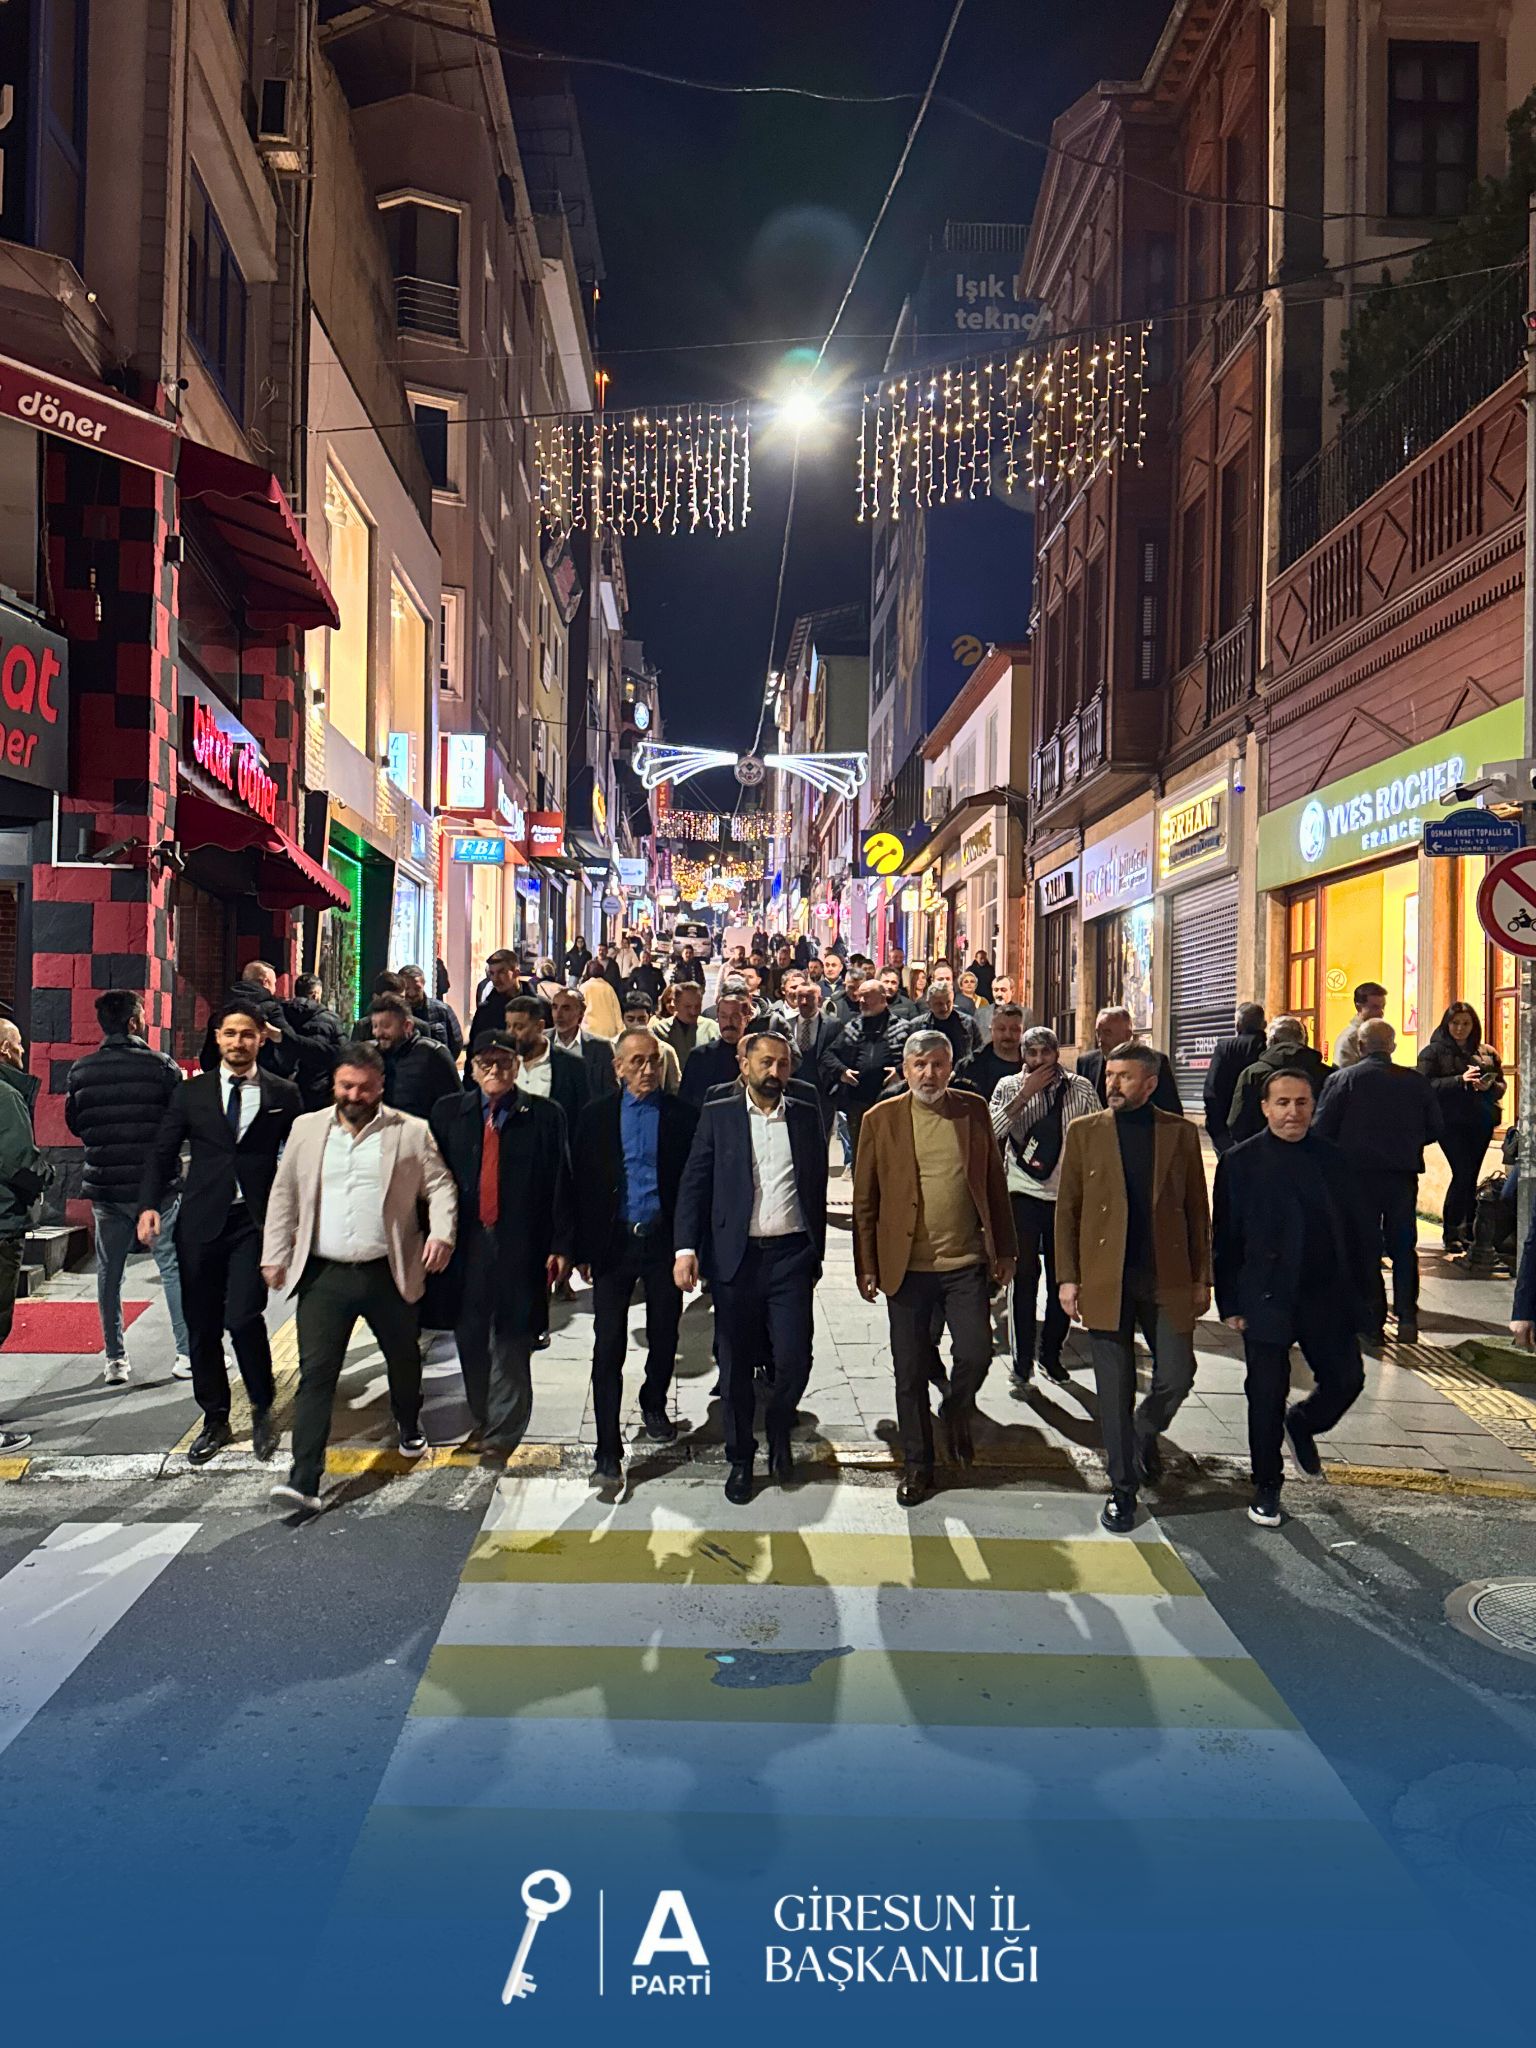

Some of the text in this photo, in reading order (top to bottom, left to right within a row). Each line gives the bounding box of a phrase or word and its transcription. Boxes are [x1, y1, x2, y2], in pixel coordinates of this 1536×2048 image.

[18, 391, 107, 442] döner
[0, 637, 61, 724] at
[1326, 757, 1463, 838] YVES ROCHER
[459, 840, 499, 855] FBI
[1361, 817, 1421, 850] FRANCE
[1431, 828, 1452, 838] OSMAN
[1453, 827, 1475, 837] FİKRET
[1022, 1136, 1039, 1165] NIKE
